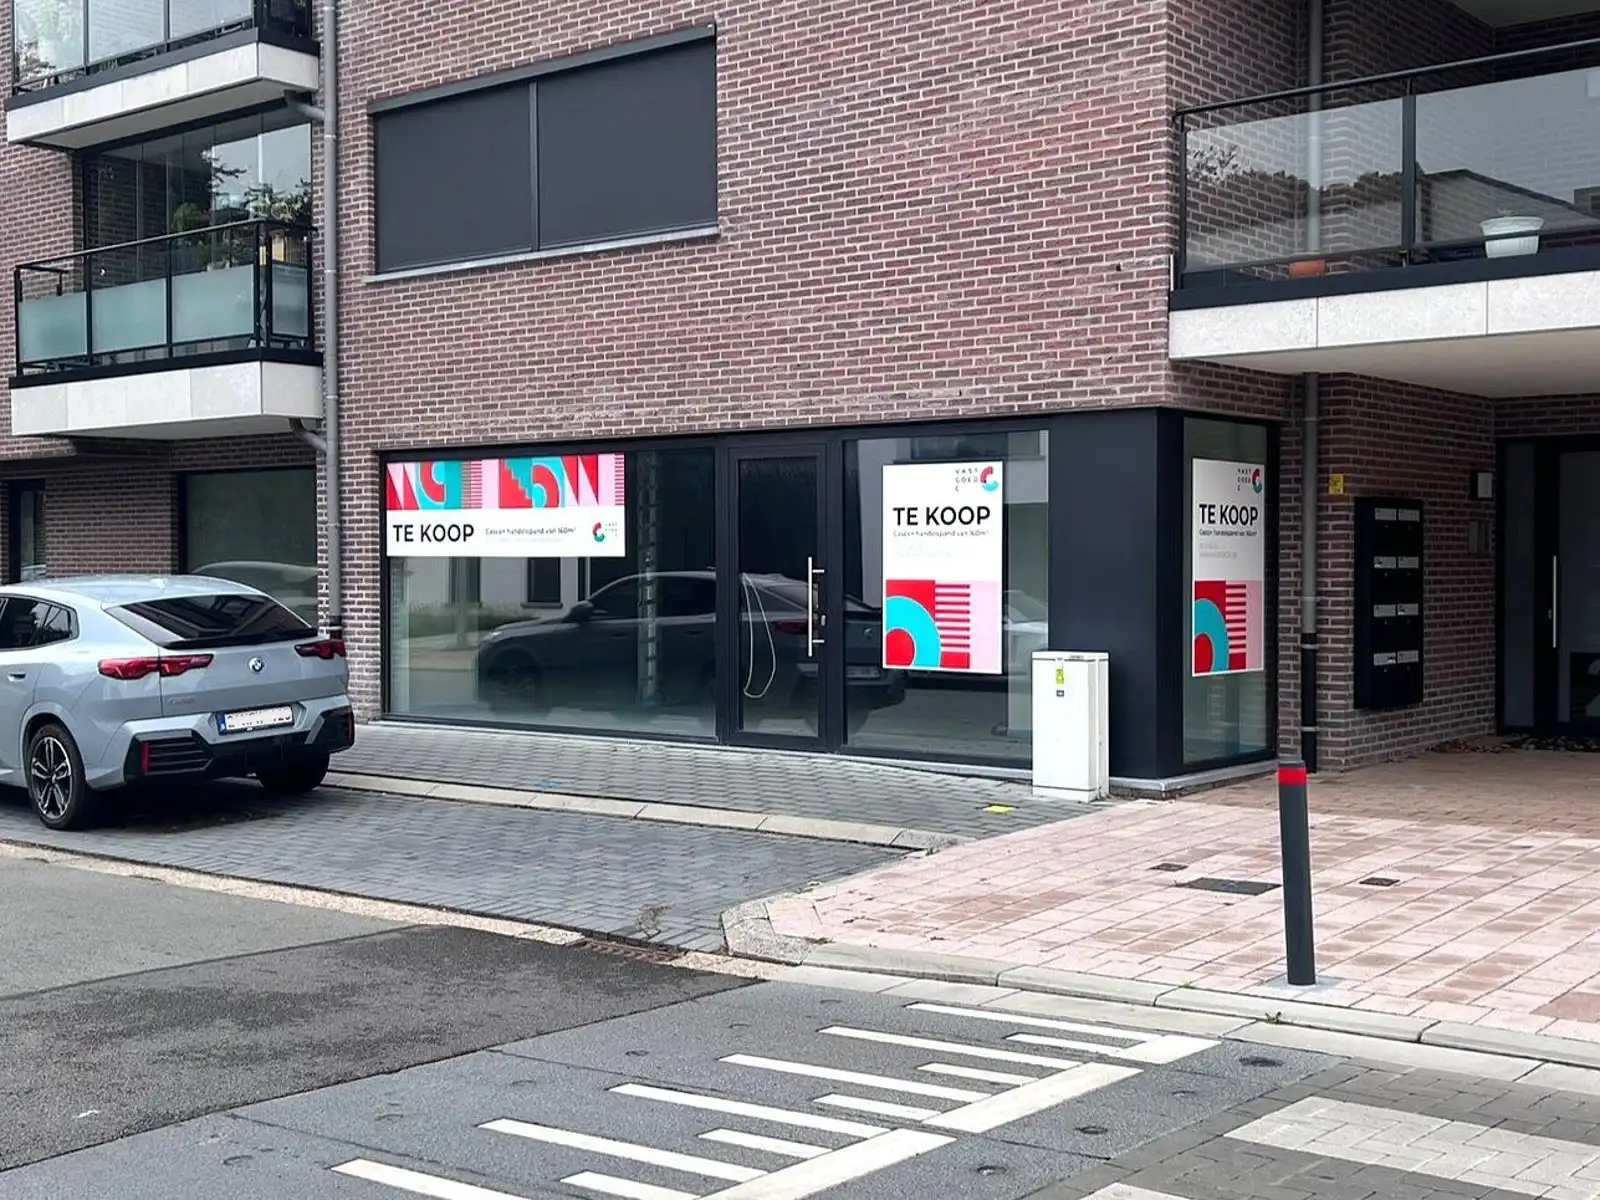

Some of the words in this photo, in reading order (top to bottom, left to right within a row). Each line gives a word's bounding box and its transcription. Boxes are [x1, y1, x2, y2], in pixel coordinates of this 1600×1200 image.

[893, 507, 918, 526] TE
[926, 506, 990, 525] KOOP
[1199, 504, 1216, 524] TE
[1220, 505, 1258, 525] KOOP
[393, 524, 413, 542] TE
[421, 524, 474, 542] KOOP
